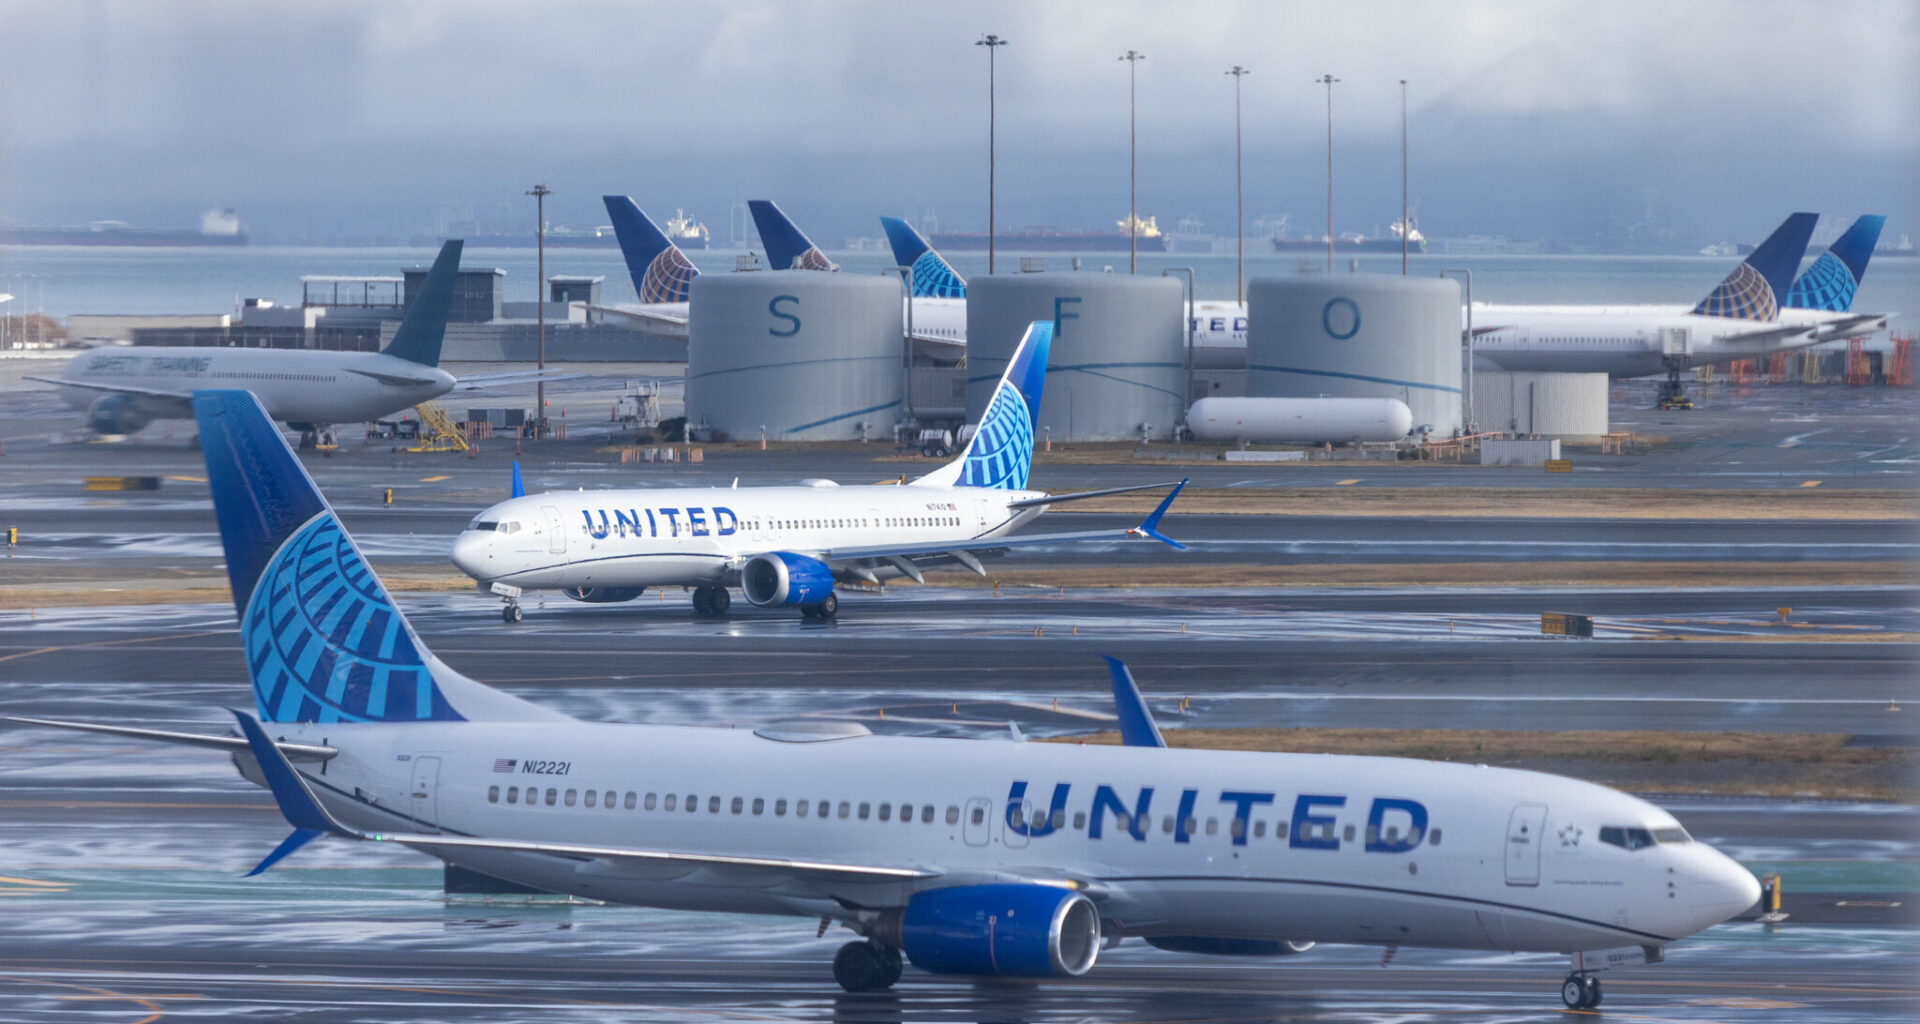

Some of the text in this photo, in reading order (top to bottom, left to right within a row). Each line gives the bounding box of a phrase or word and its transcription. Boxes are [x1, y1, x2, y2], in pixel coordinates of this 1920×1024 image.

[769, 296, 1361, 338] S F O
[583, 508, 737, 540] UNITED
[522, 760, 571, 775] N12221
[1005, 781, 1429, 852] UNITED
